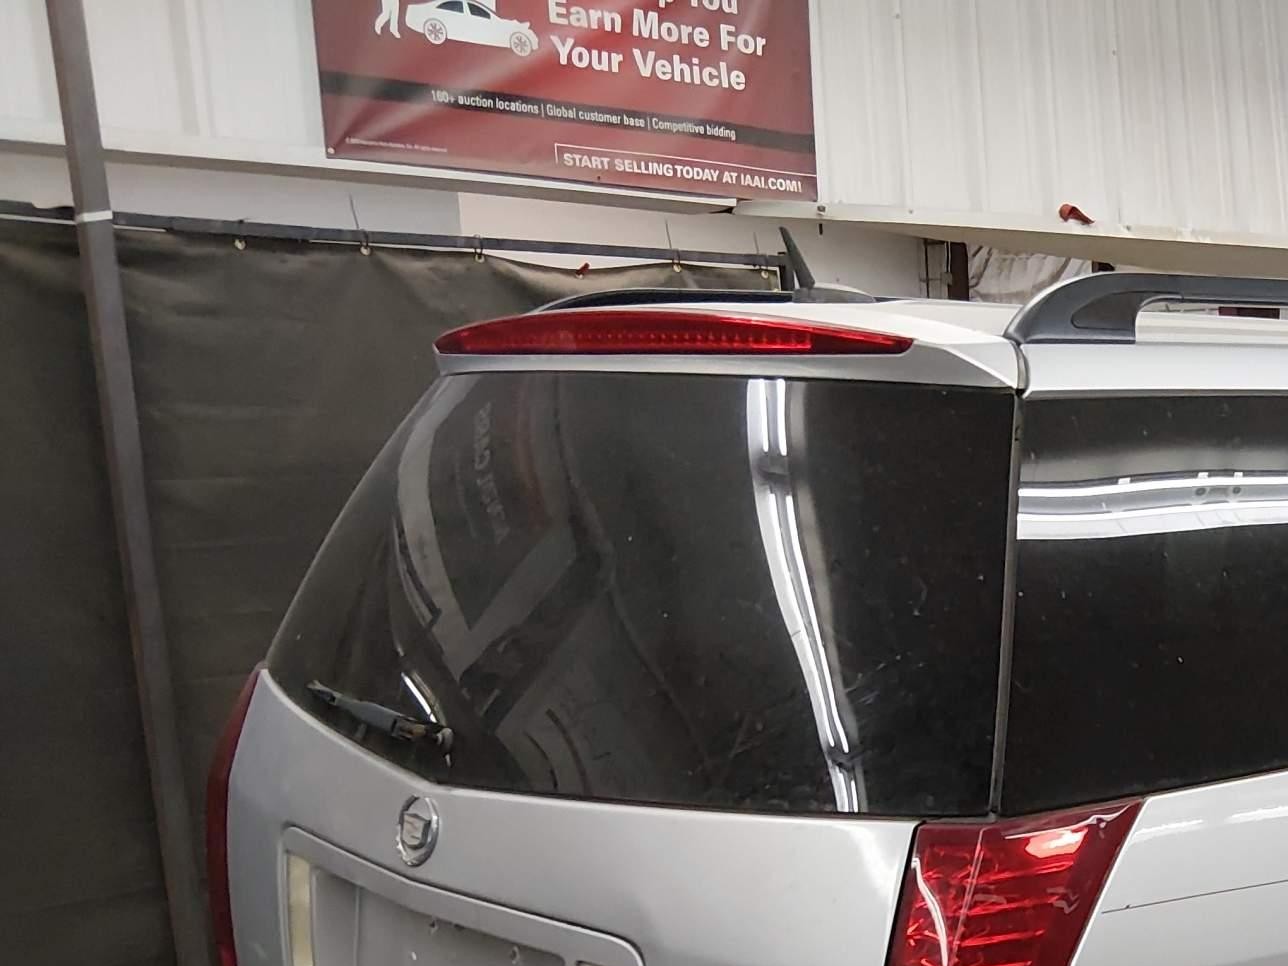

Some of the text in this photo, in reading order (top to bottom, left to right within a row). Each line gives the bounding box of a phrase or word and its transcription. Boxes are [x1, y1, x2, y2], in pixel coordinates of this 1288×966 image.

[548, 0, 766, 56] Earn More For
[690, 0, 738, 14] ou
[550, 35, 746, 90] Your Vehicle
[457, 94, 494, 109] auction
[495, 97, 539, 114] locations
[546, 104, 576, 119] Global
[578, 109, 621, 124] customer
[623, 113, 645, 127] base
[652, 117, 705, 134] Competitive
[706, 123, 736, 141] bidding
[563, 153, 802, 192] START SELLING TODAY AT IAAI.COM!
